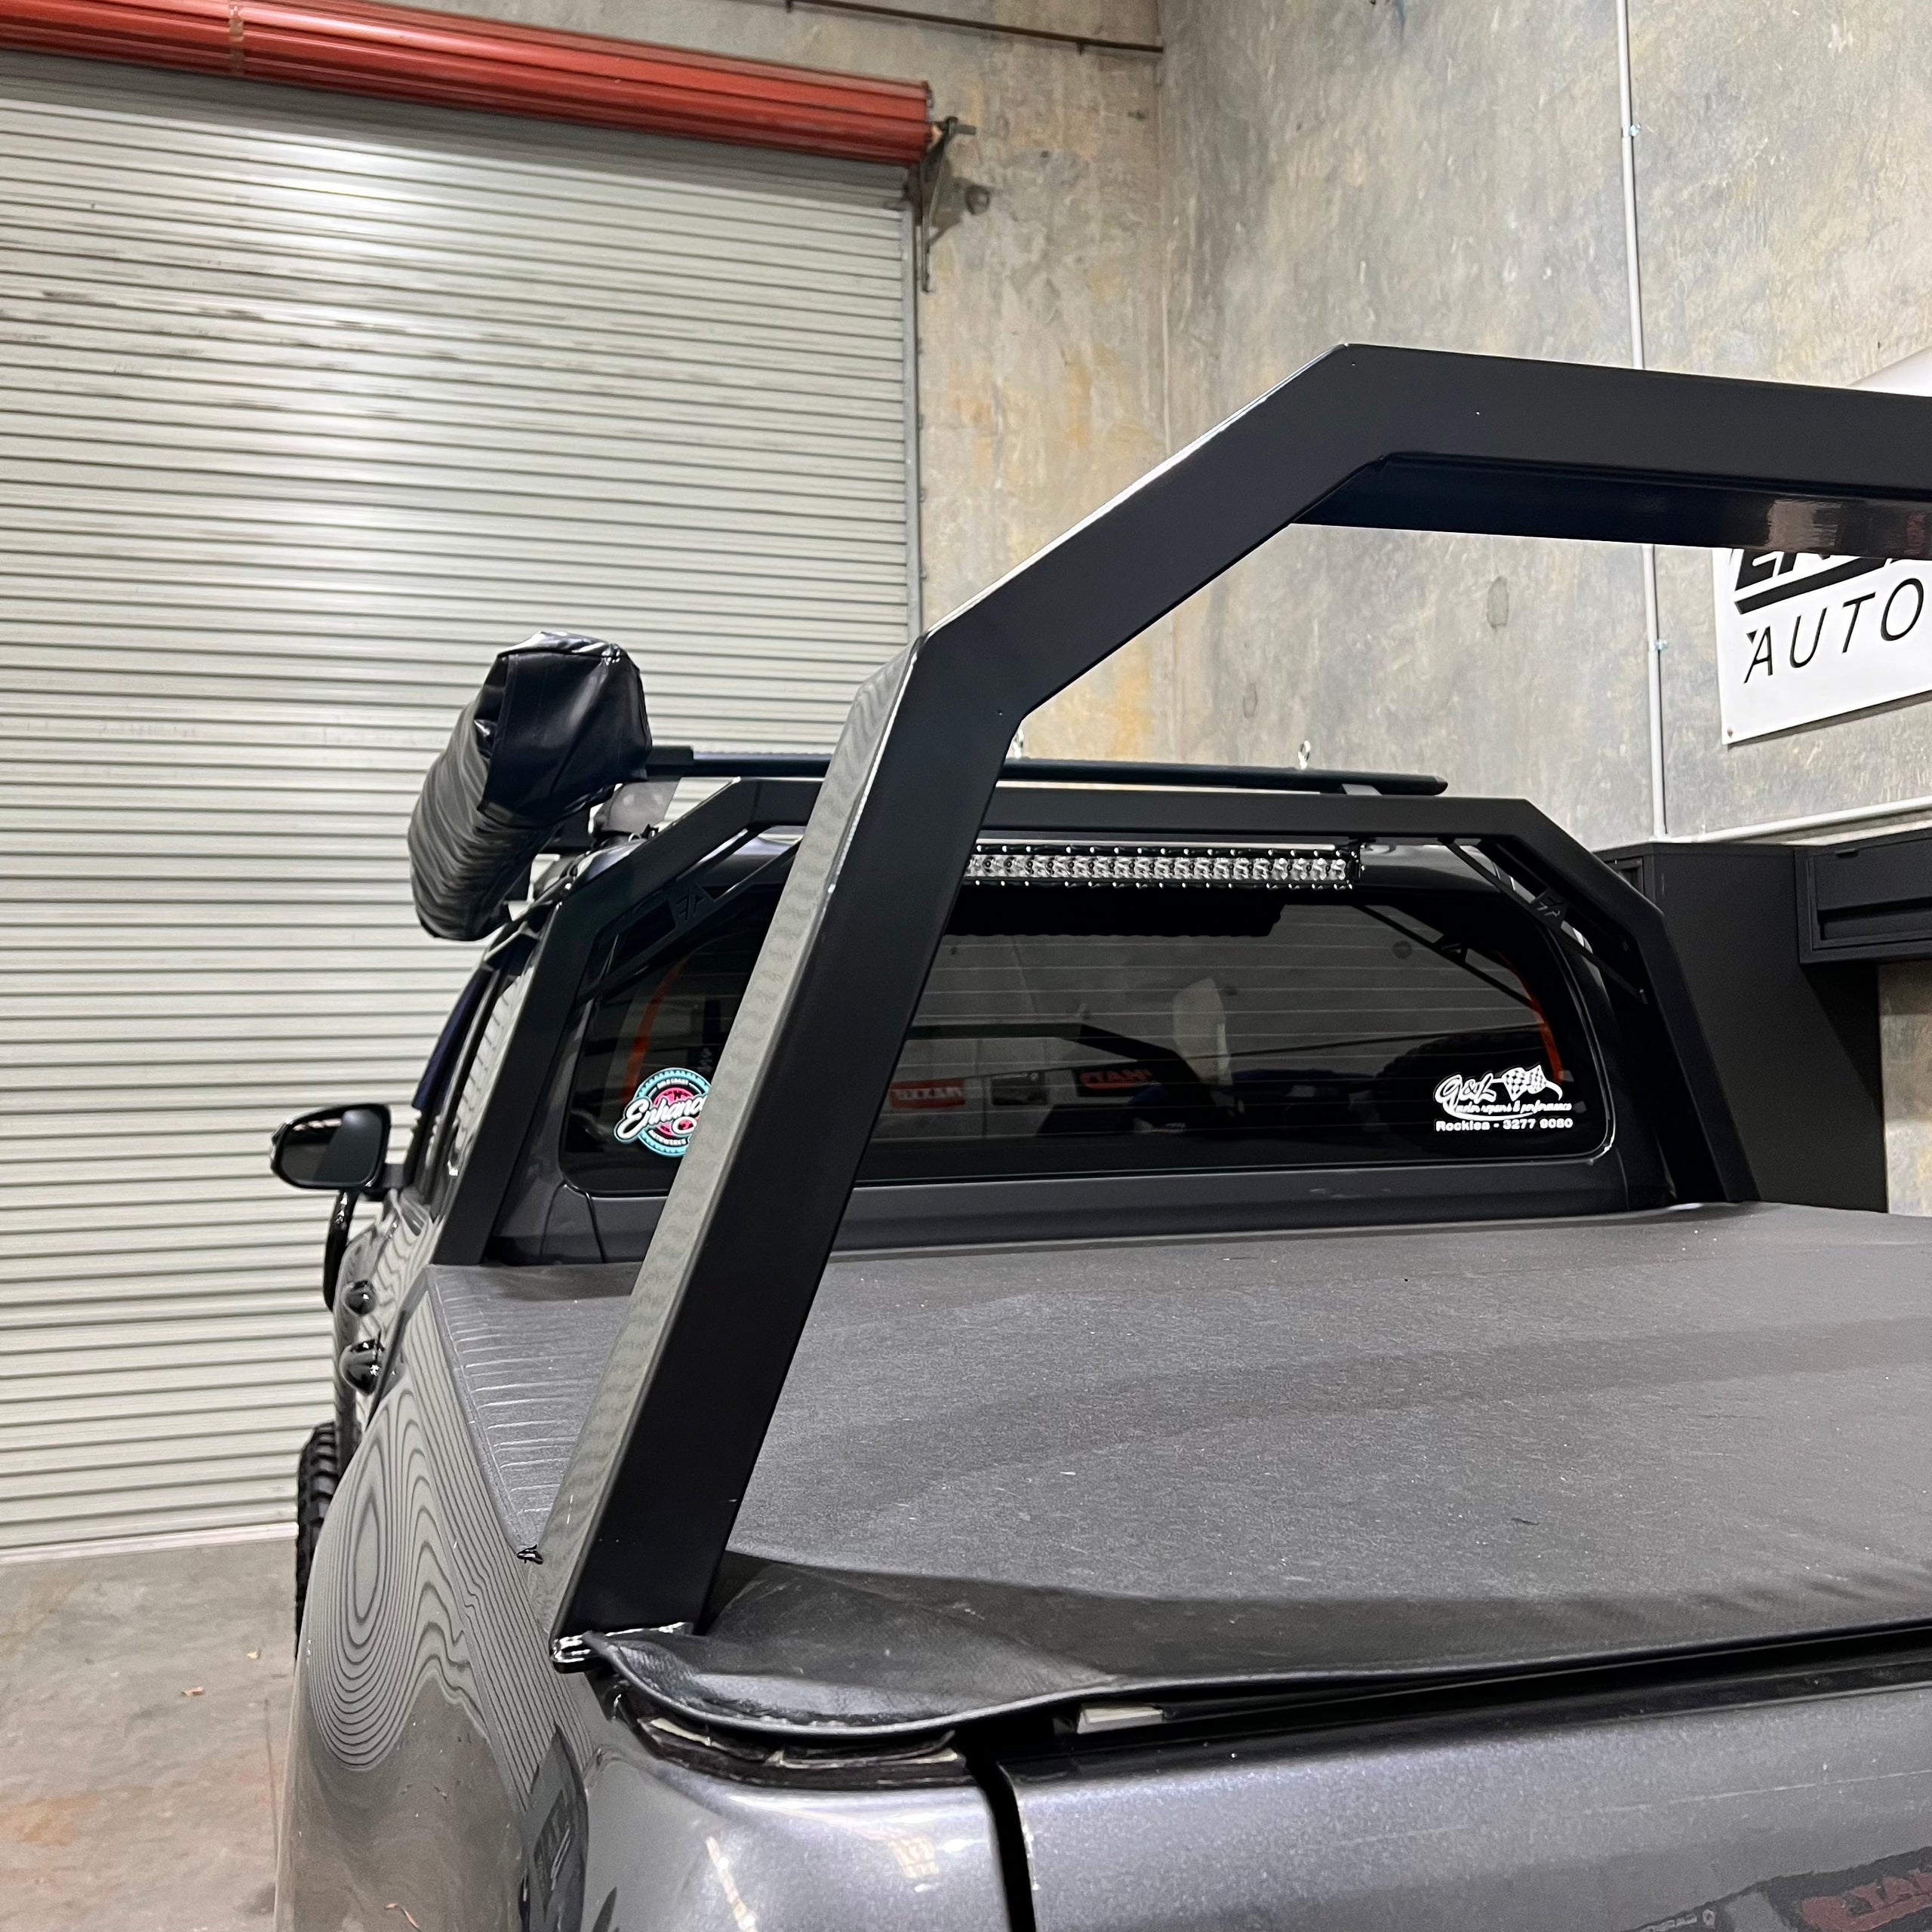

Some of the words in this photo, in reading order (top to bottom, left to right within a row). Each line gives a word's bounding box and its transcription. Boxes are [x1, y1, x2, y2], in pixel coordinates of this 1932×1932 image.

[1743, 577, 1924, 684] AUTO
[617, 1095, 708, 1140] Enhanc
[1503, 1118, 1536, 1130] 3277
